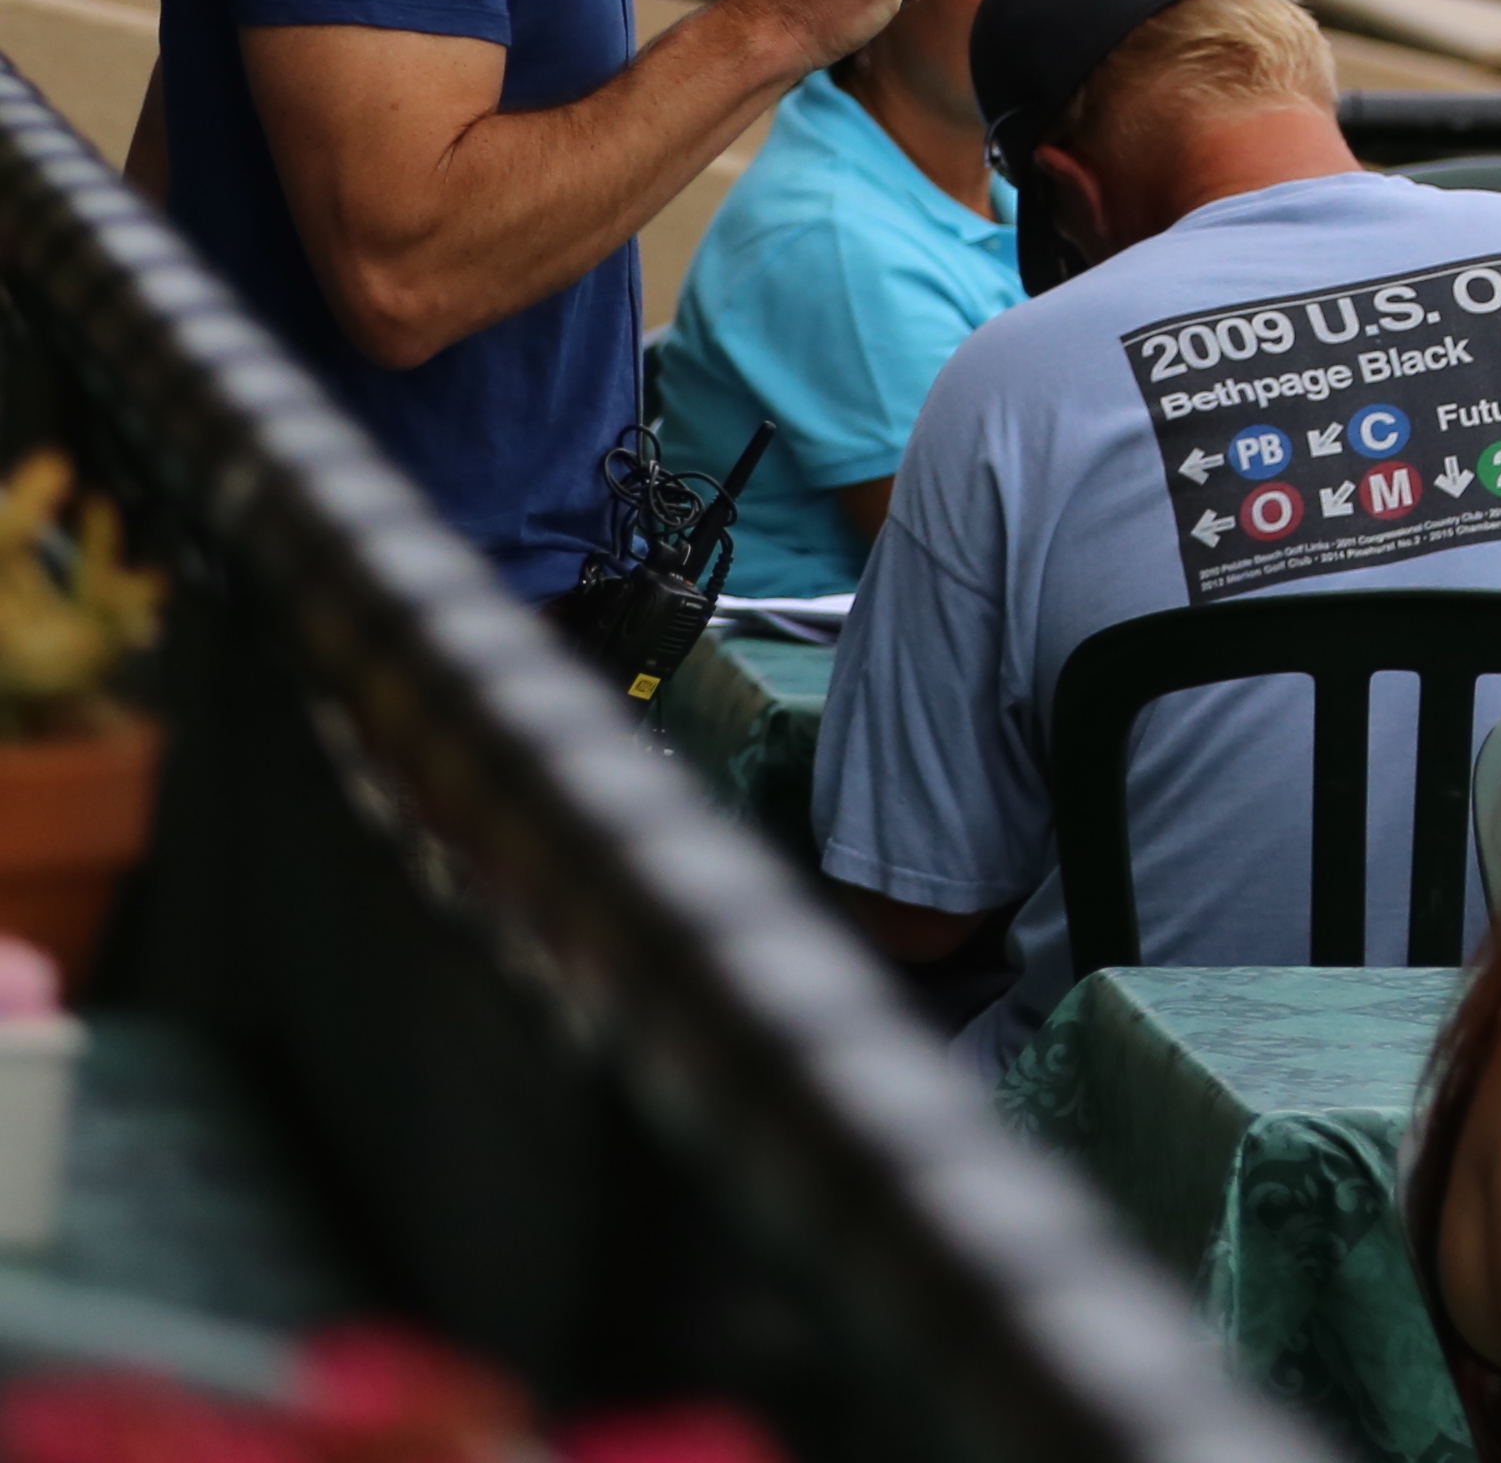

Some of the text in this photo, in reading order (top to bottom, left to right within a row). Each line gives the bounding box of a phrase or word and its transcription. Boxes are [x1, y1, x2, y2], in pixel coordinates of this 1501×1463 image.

[1141, 311, 1295, 383] 2009
[1306, 285, 1440, 345] U.S.
[1161, 336, 1473, 420] Bethpage Black
[1236, 412, 1399, 471] PB C
[1252, 491, 1292, 534] O
[1368, 469, 1413, 513] M
[1424, 514, 1460, 530] Country
[1461, 511, 1483, 522] Club
[1264, 562, 1286, 574] Golf
[1288, 556, 1312, 569] Club
[1347, 541, 1396, 559] Pinehurst
